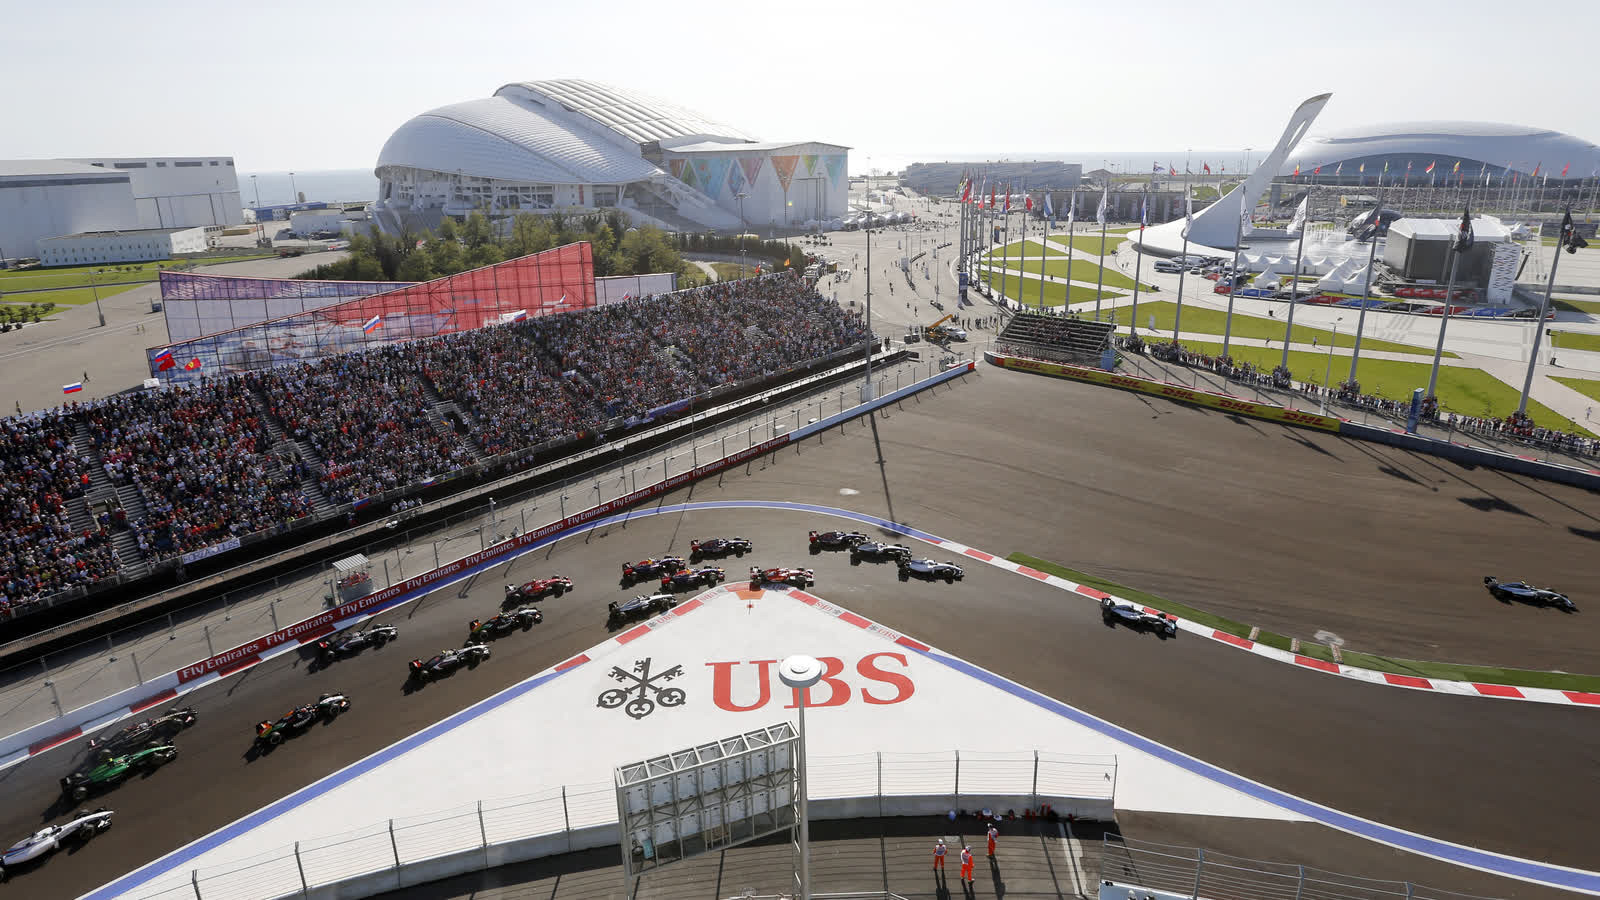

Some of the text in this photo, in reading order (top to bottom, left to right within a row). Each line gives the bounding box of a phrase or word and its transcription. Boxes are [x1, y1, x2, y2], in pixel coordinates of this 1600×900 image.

[1161, 387, 1195, 400] DHL
[1218, 399, 1257, 413] DHL
[1282, 412, 1324, 426] DHL
[654, 473, 690, 492] Fly Emirates
[613, 488, 652, 508] Fly Emirates
[568, 504, 609, 526] Fly Emirates
[519, 522, 564, 545] Fly Emirates
[465, 542, 515, 567] Fly Emirates
[406, 562, 461, 589] Fly Emirates
[340, 586, 400, 616] Fly Emirates
[266, 614, 334, 646] Fly Emirates
[182, 643, 259, 679] Fly Emirates
[705, 652, 915, 713] UBS
